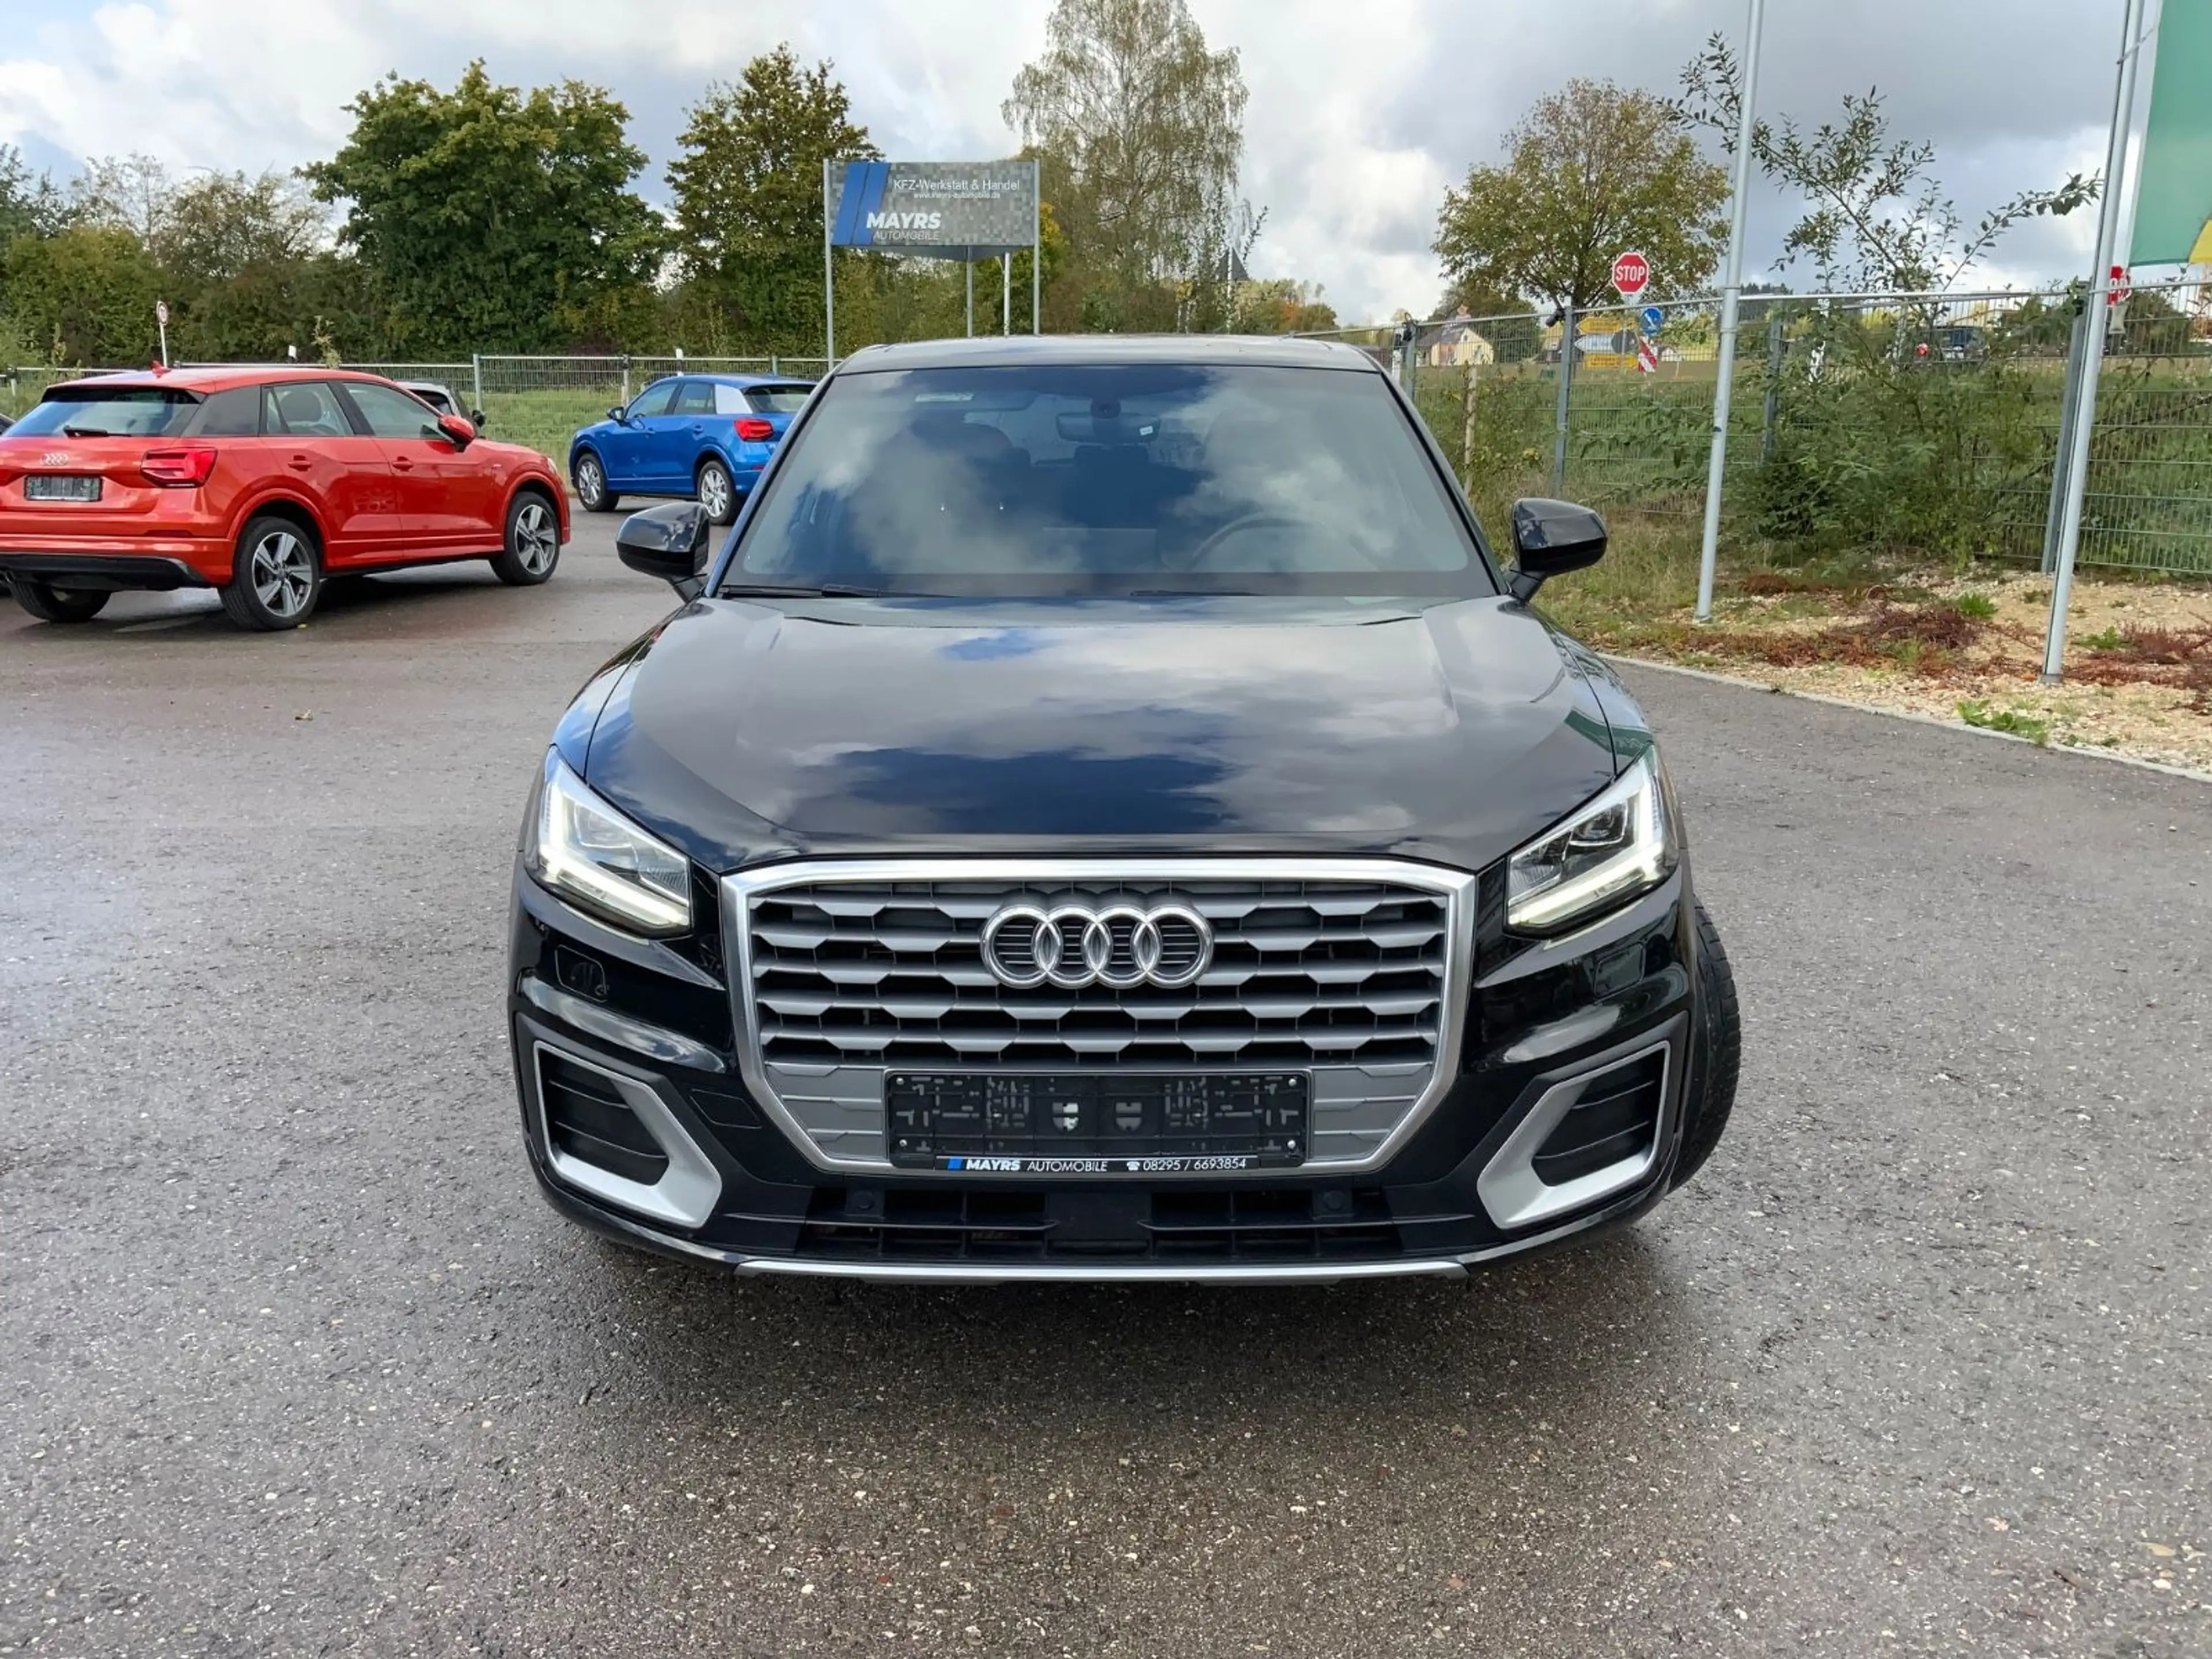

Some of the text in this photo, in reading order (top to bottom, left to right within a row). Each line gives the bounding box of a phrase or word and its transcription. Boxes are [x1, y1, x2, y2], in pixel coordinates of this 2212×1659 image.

[893, 179, 1020, 190] KFZ-Werkstatt & Handel
[866, 212, 941, 229] MAYRS
[873, 231, 940, 240] AUTOMOBILE
[1615, 266, 1644, 282] STOP
[966, 1158, 1246, 1172] MAYRS AUTOMOBILE 08295 / 6693854
